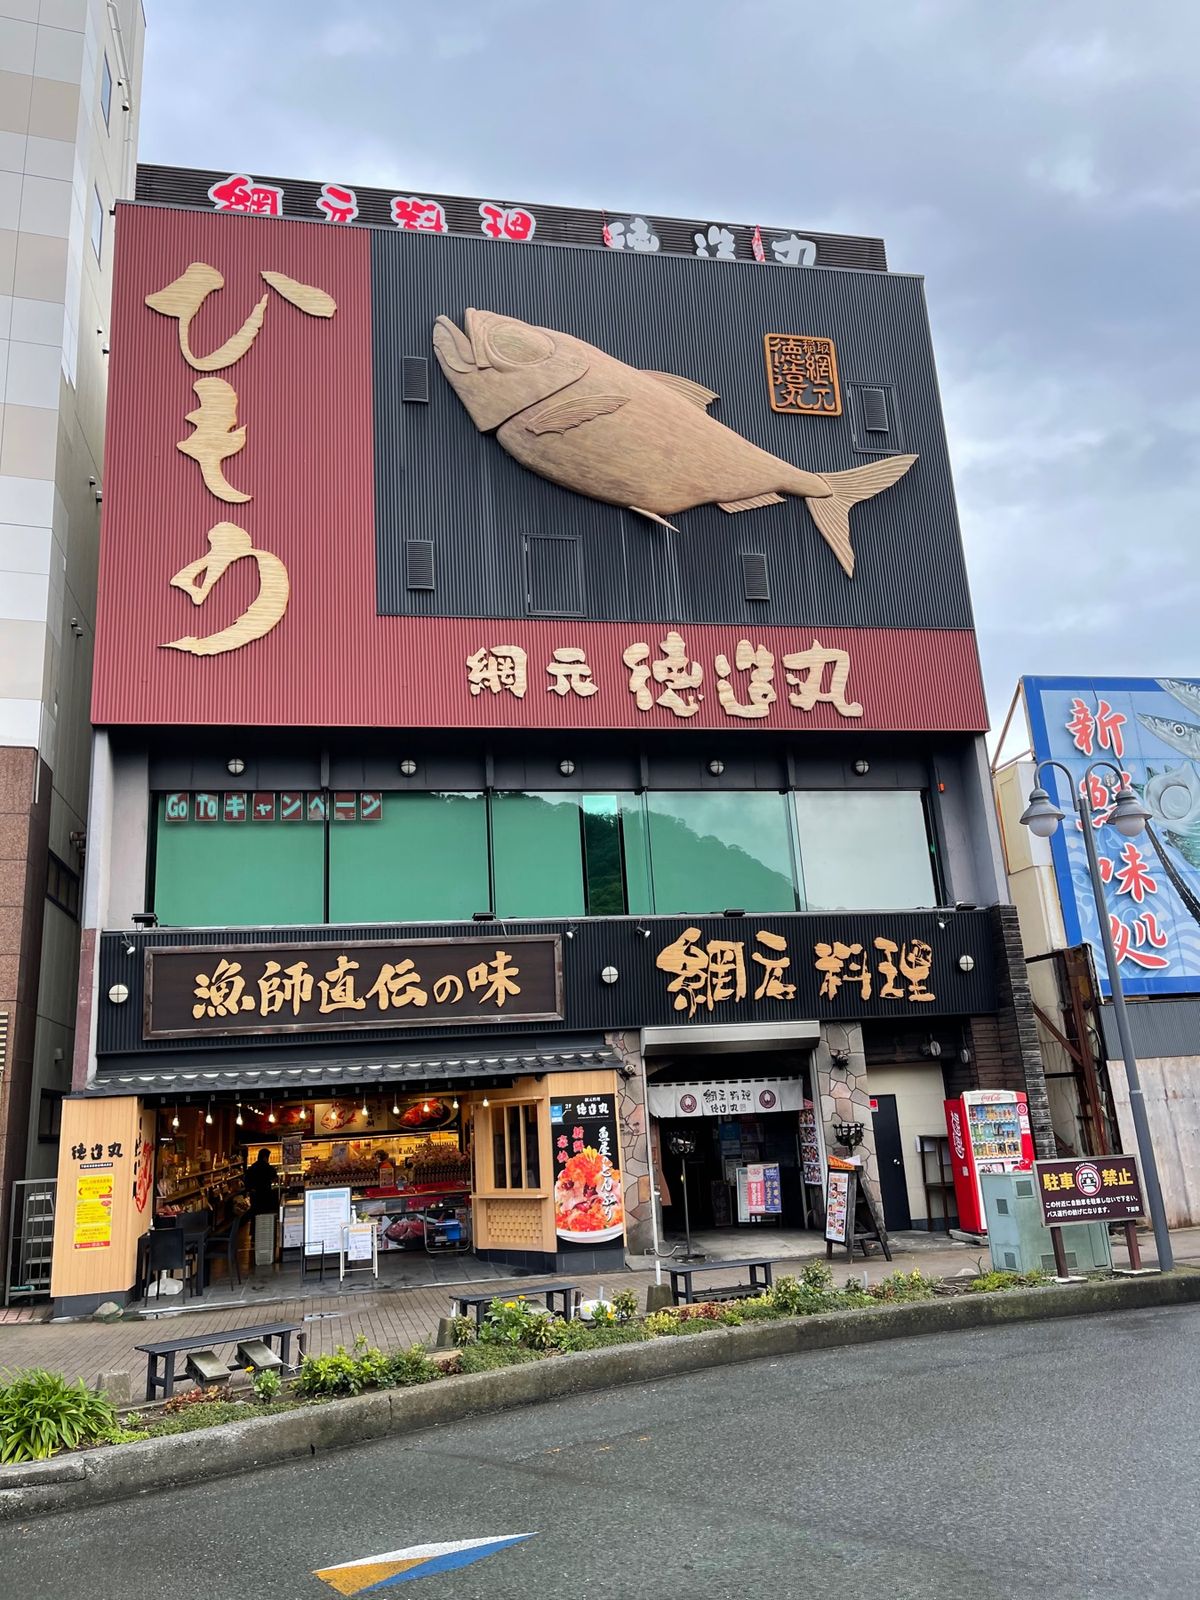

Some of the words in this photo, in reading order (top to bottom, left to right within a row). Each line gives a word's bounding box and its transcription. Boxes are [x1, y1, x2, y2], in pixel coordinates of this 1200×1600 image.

[145, 262, 337, 656] ひもの
[167, 795, 187, 817] Go
[197, 795, 216, 817] To
[192, 950, 521, 1019] 漁師直伝の味
[71, 1142, 123, 1160] 徳造丸
[950, 1110, 965, 1159] Coca-Cola
[1043, 1172, 1075, 1191] 駐車
[1101, 1168, 1134, 1187] 禁止
